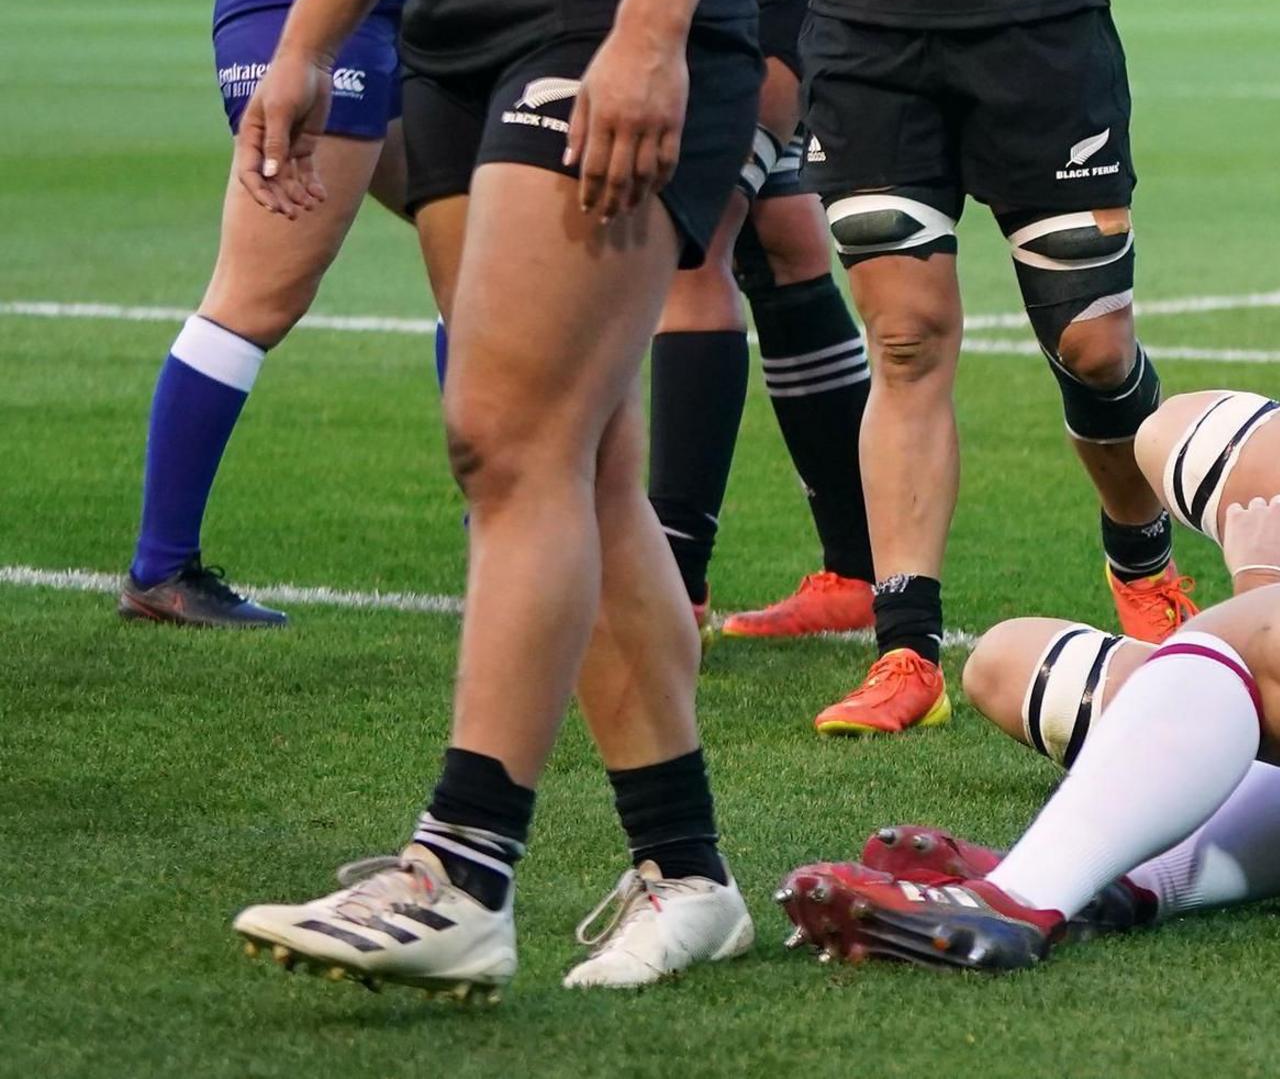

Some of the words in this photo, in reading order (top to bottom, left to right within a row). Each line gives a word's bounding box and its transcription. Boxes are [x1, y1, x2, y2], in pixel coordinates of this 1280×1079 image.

[502, 111, 541, 127] BLACK
[541, 115, 569, 133] FER
[1056, 168, 1090, 180] BLACK
[1092, 164, 1119, 176] FERNS
